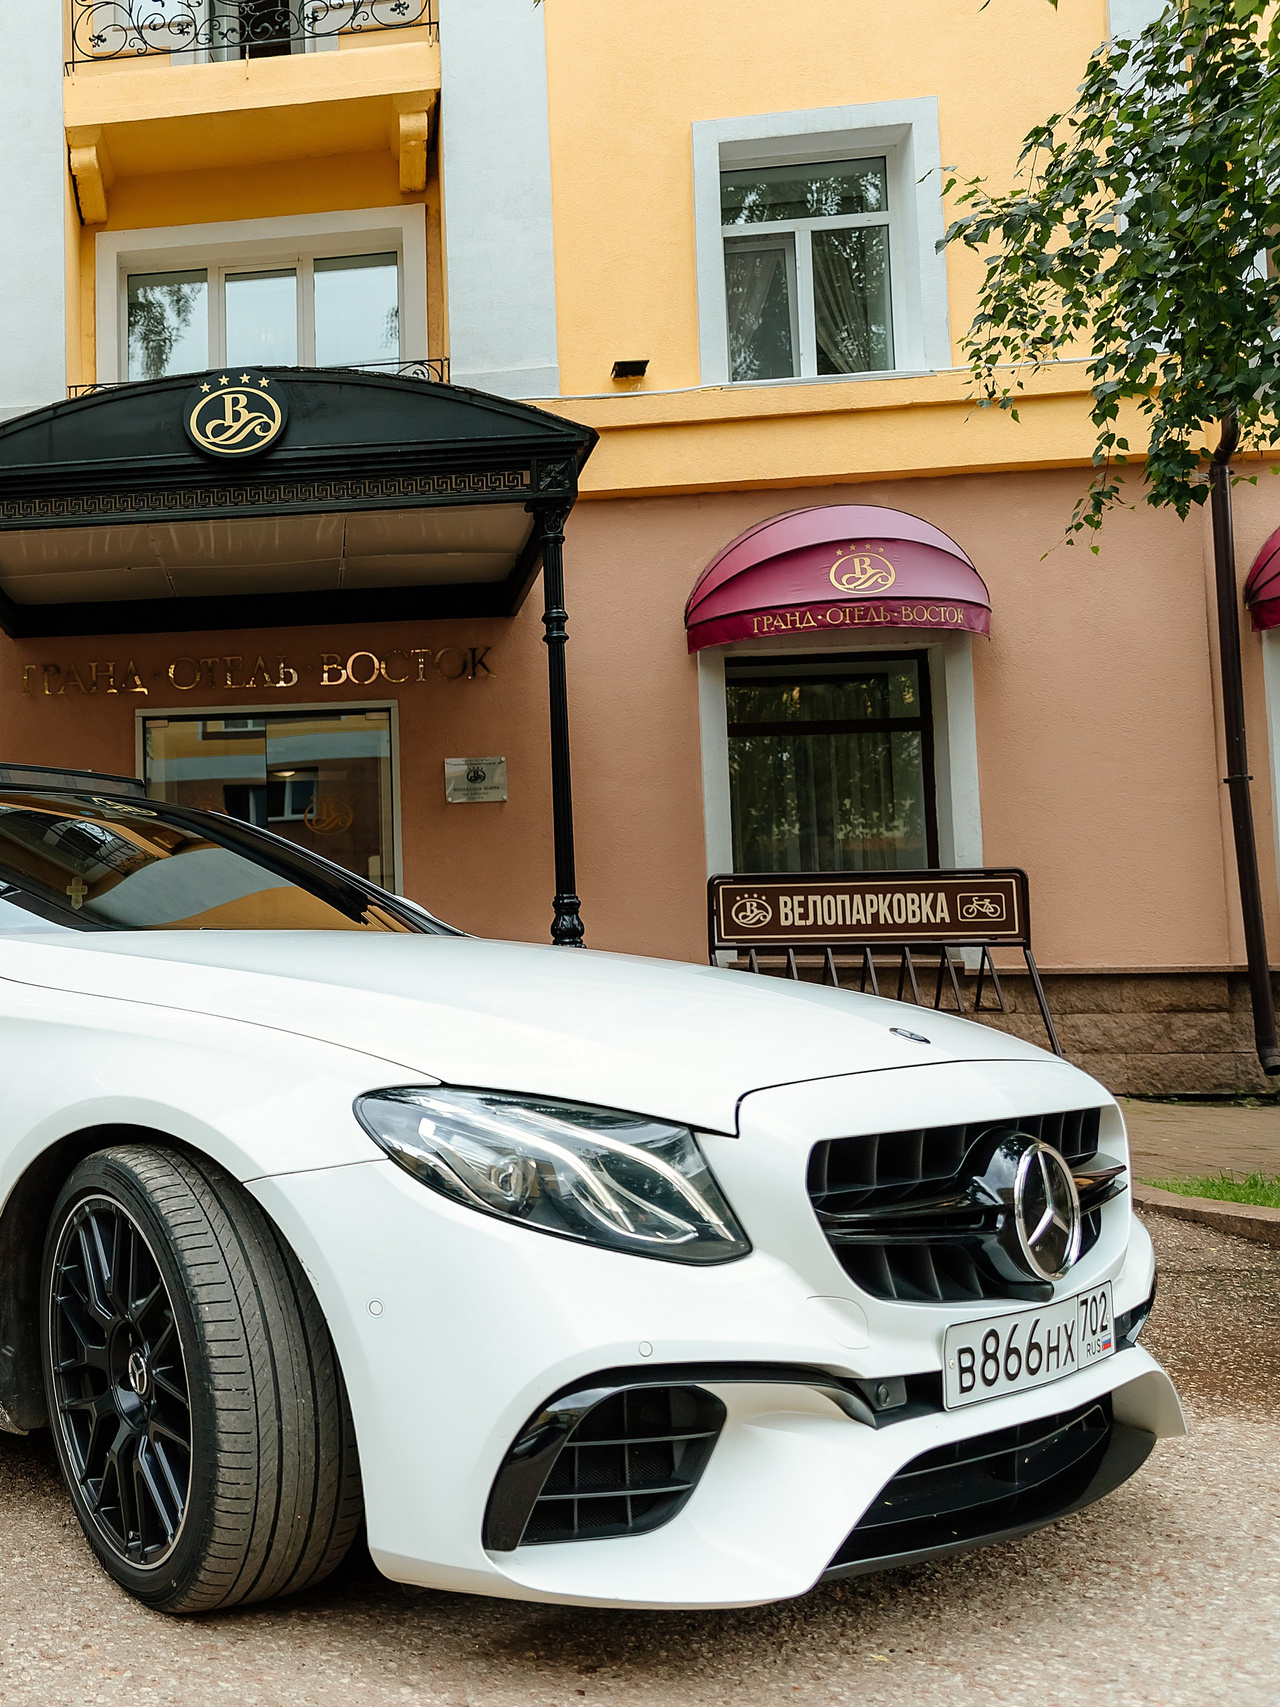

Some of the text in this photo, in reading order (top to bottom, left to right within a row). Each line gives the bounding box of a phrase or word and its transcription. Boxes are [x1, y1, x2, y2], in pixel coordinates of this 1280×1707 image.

[752, 605, 965, 633] ГРАНД ОТЕЛЬ ВОСТОК
[21, 646, 498, 697] ГРАНД ОТЕЛЬ ВОСТОК
[778, 892, 951, 926] ВЕЛОПАРКОВКА
[1079, 1290, 1109, 1342] 702
[1086, 1338, 1101, 1358] RUS
